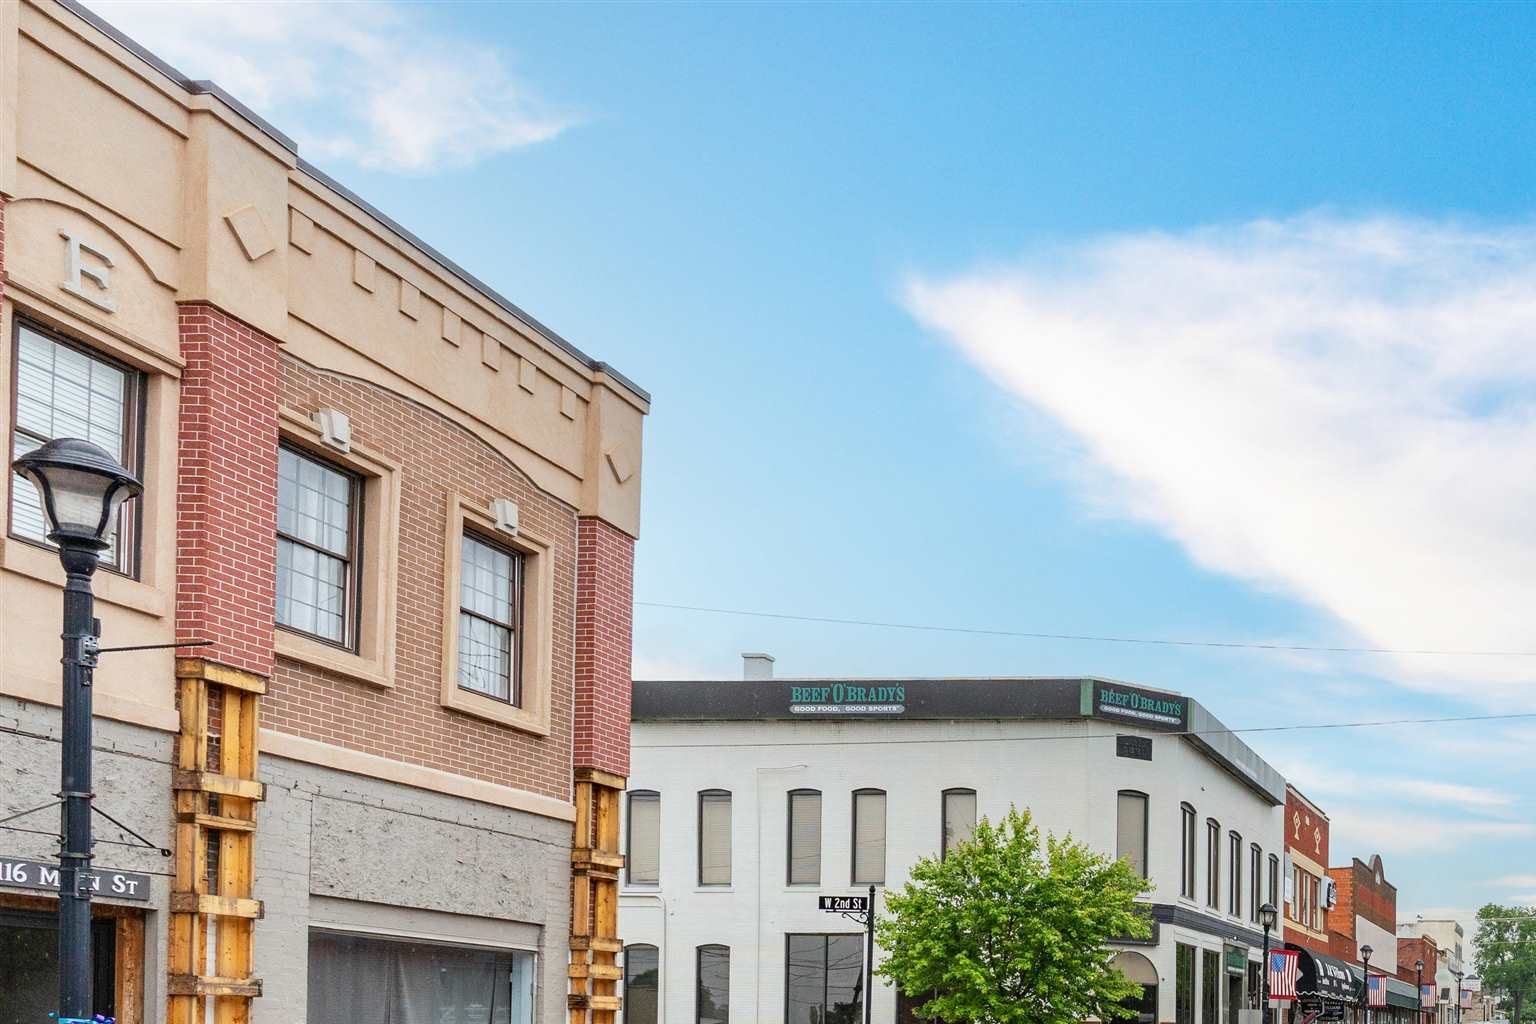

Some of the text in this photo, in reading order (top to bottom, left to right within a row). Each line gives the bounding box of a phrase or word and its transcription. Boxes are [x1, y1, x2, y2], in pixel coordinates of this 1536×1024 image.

[38, 866, 101, 891] MN
[824, 897, 862, 909] W 2nd St
